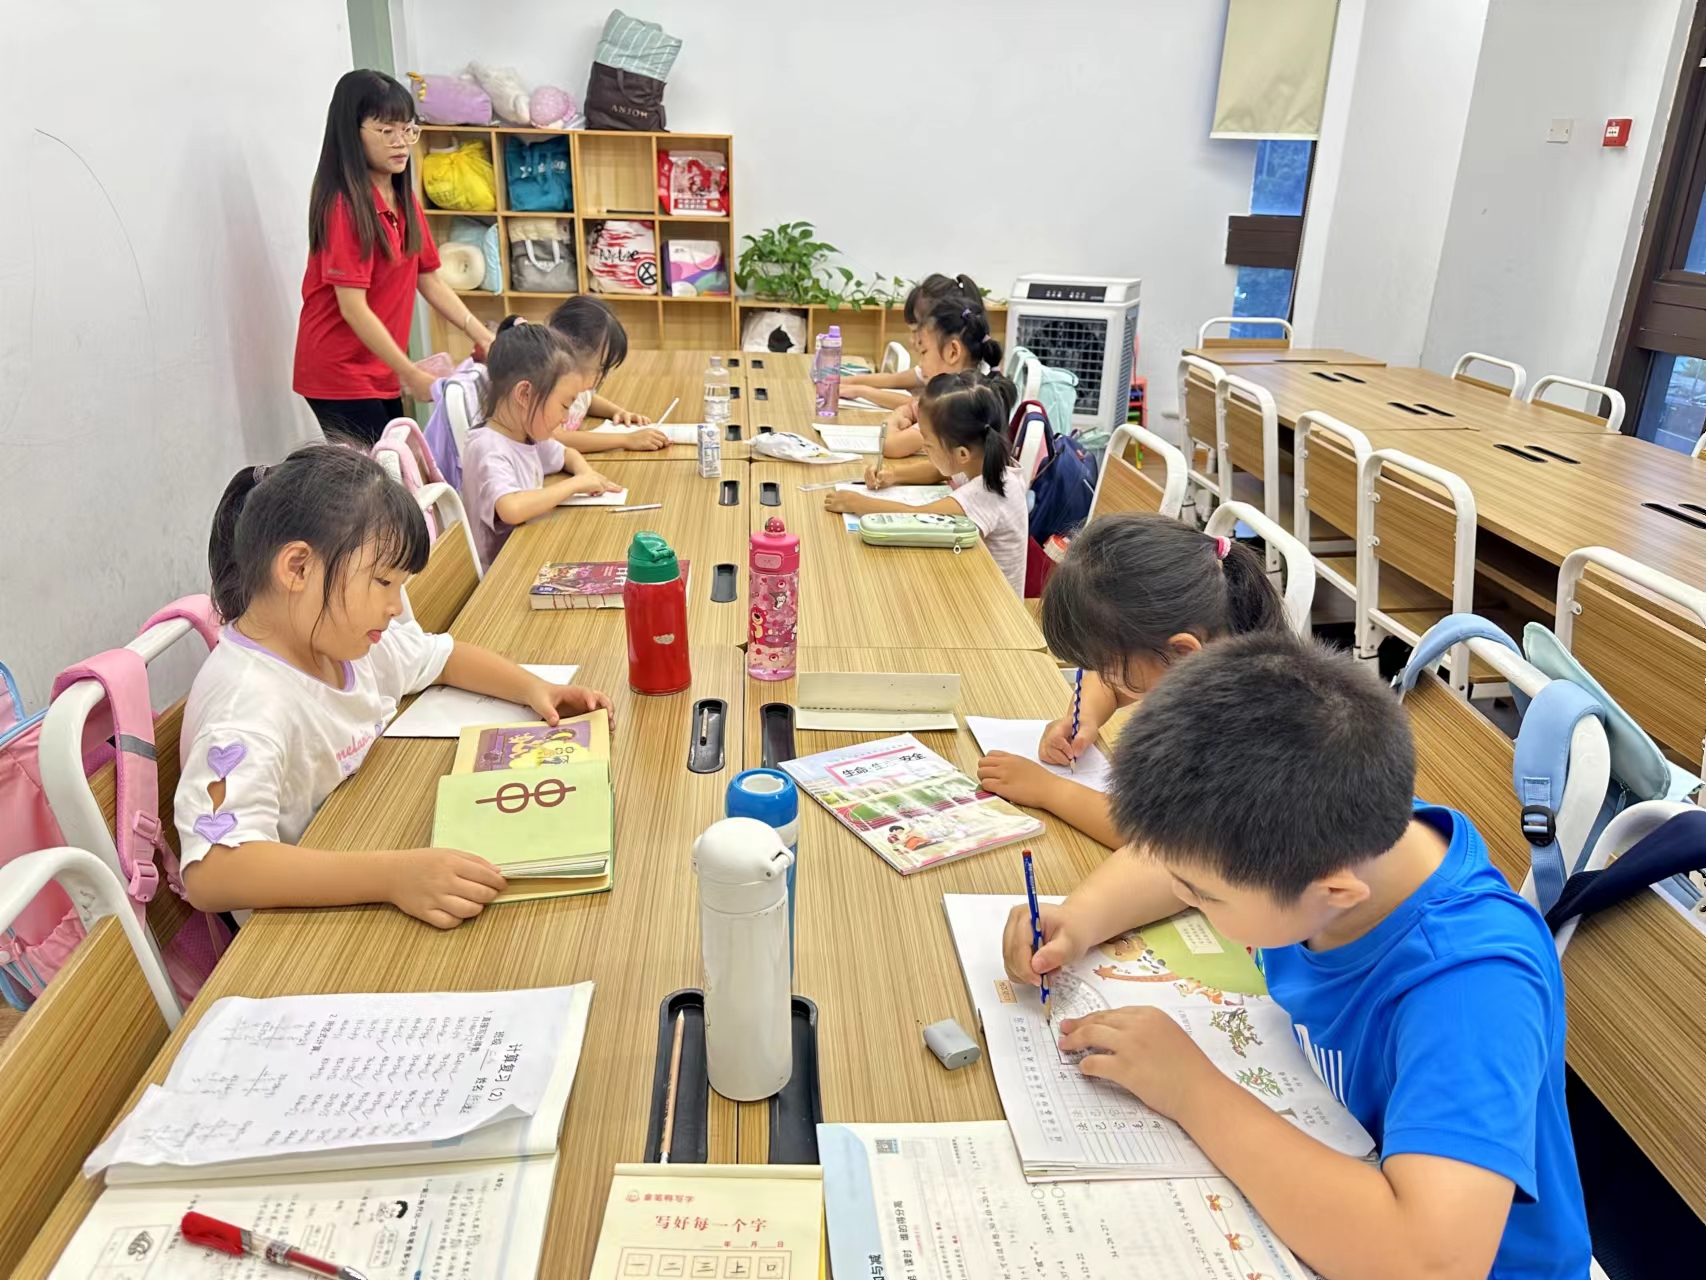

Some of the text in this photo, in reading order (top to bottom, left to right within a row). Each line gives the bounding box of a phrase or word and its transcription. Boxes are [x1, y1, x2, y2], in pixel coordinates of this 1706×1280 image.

[655, 1215, 767, 1233] 写好每一个字
[893, 1200, 909, 1241] 谁的得分高
[696, 1261, 714, 1272] 三
[729, 1259, 747, 1274] 上
[765, 1263, 777, 1272] 口
